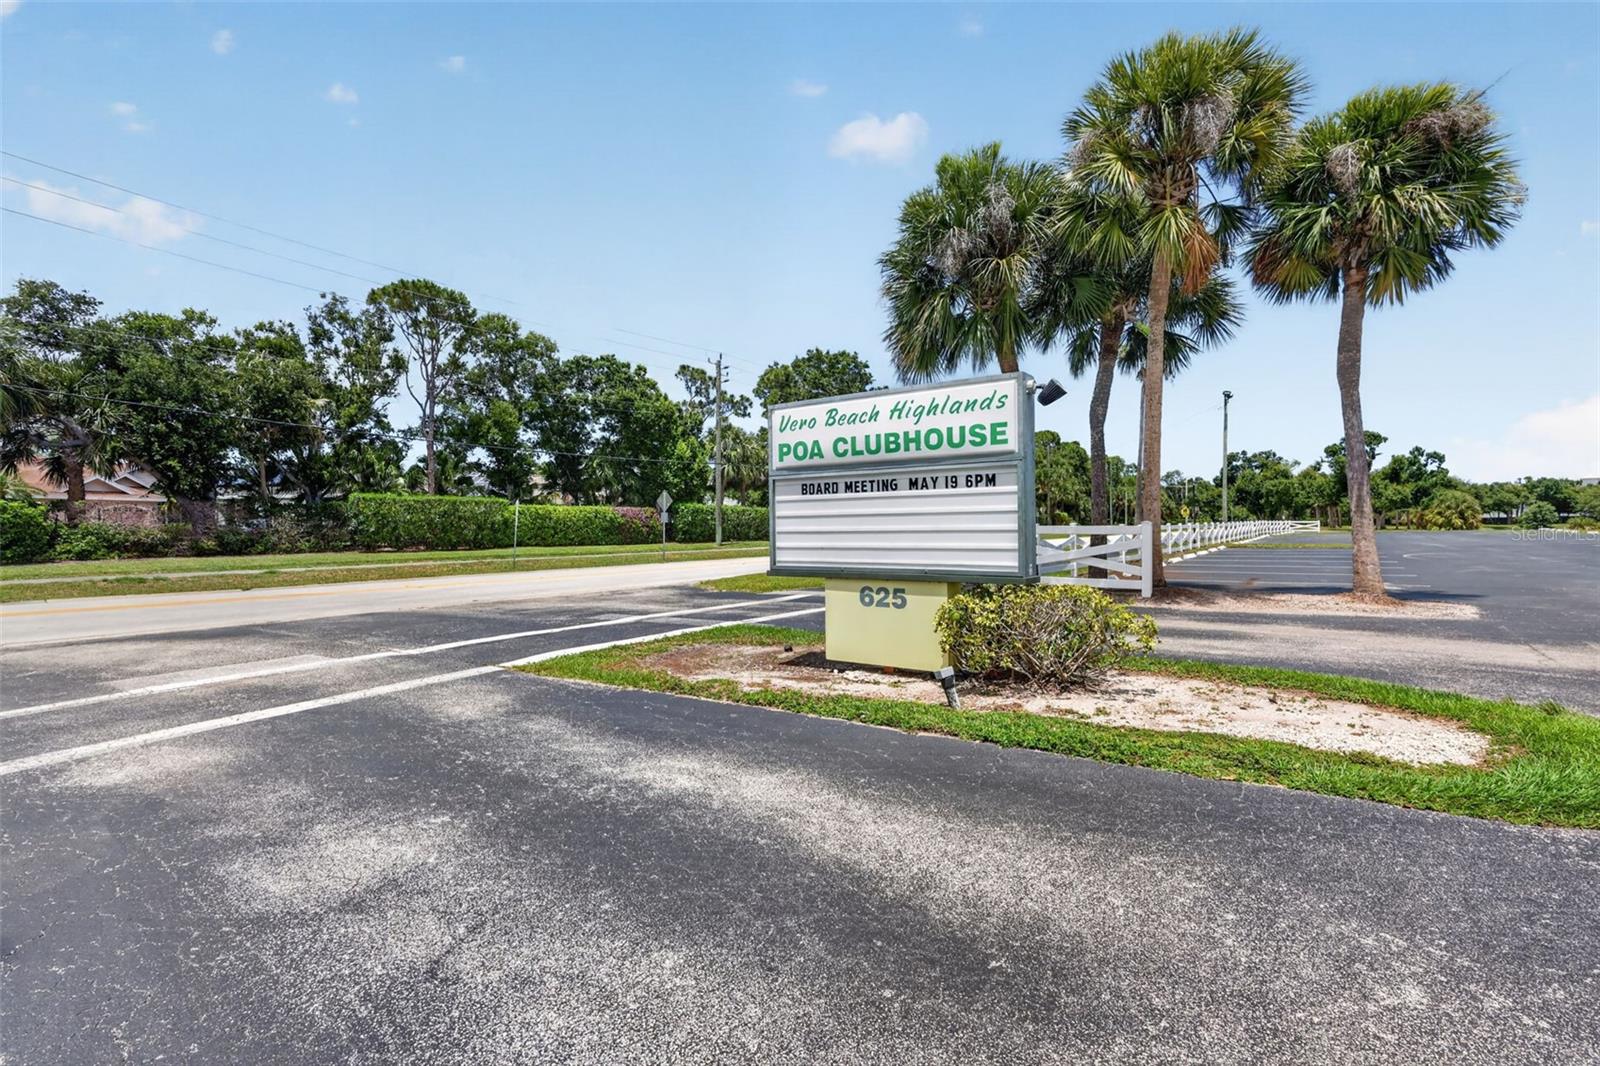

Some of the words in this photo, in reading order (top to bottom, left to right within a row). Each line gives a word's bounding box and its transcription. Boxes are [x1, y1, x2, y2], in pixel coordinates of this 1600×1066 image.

[779, 415, 817, 433] Vero
[825, 404, 880, 427] Beach
[888, 389, 1009, 426] Highlands
[778, 440, 824, 462] POA
[832, 421, 1009, 458] CLUBHOUSE
[801, 483, 839, 496] BOARD
[844, 479, 898, 494] MEETING
[908, 476, 939, 490] MAY
[945, 475, 958, 489] 19
[965, 473, 997, 488] 6PM
[859, 585, 907, 609] 625
